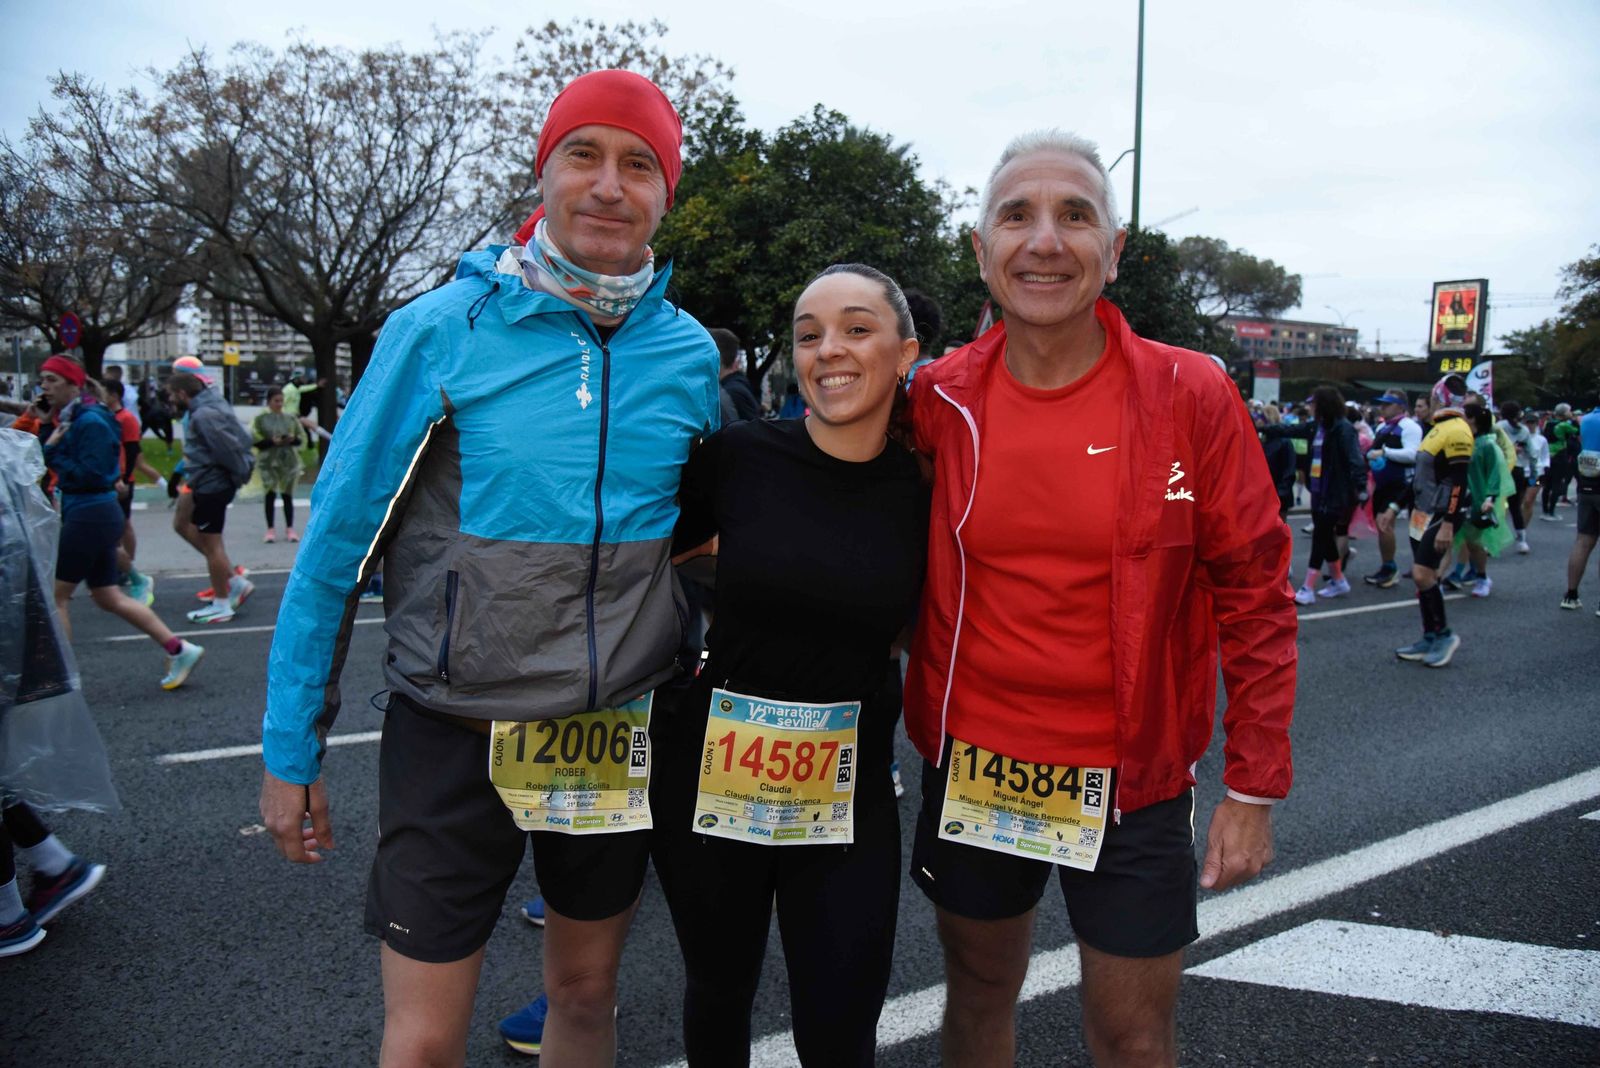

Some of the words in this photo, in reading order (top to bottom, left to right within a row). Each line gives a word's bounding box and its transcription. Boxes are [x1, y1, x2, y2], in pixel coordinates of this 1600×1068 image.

[1164, 487, 1195, 502] iuk
[763, 704, 821, 720] maratón
[776, 717, 819, 729] sevilla
[509, 720, 631, 765] 12006
[494, 738, 504, 767] CAJÓN
[703, 748, 714, 775] CAJÓN
[718, 730, 840, 782] 14587
[555, 767, 586, 777] ROBER
[952, 758, 961, 782] CAJÓN
[963, 744, 1082, 801] 14584
[525, 782, 559, 791] Roberto
[759, 782, 792, 794] Claudia
[724, 789, 756, 802] Claudia
[756, 795, 793, 807] Guerrero
[793, 798, 822, 806] Cuenca
[993, 789, 1019, 803] Miguel
[1020, 795, 1044, 809] Ángel
[959, 794, 983, 806] Miguel
[984, 800, 1006, 812] Ángel
[1041, 813, 1081, 825] Bermúdez
[545, 816, 571, 826] HOKA
[747, 826, 771, 837] HOKA
[777, 830, 802, 838] Sprinter
[992, 833, 1015, 845] HOKA
[1019, 841, 1048, 852] Sprinter
